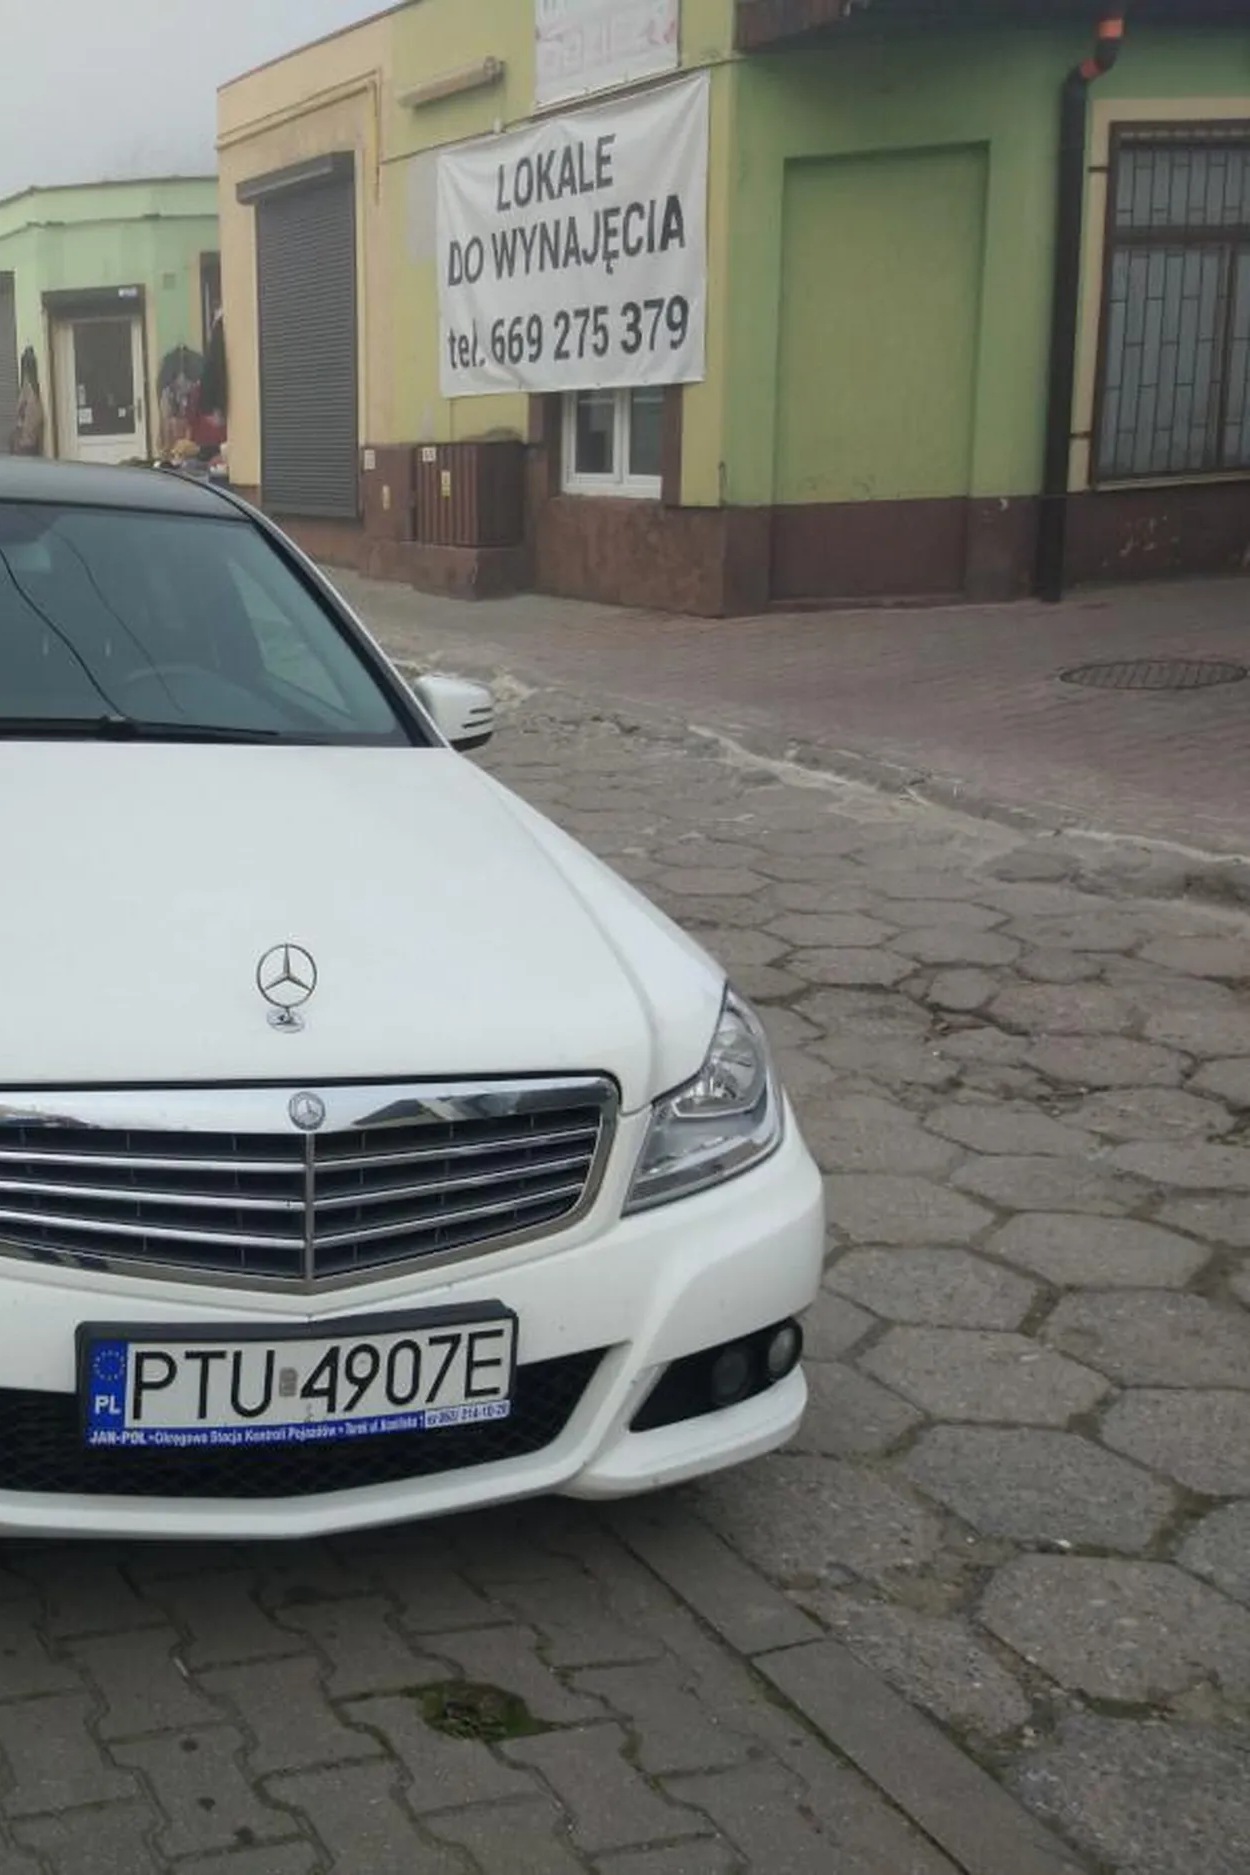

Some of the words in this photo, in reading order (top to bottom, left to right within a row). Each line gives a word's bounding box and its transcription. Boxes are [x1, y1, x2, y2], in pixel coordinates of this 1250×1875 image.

[497, 133, 616, 212] LOKALE
[448, 236, 484, 287] DO
[491, 194, 686, 281] WYNAJĘCIA
[449, 317, 486, 370] tel.
[491, 313, 543, 365] 669
[553, 304, 609, 361] 275
[620, 294, 689, 354] 379
[94, 1394, 121, 1415] PL
[133, 1349, 276, 1420] PTU
[300, 1328, 505, 1414] 4907E
[90, 1430, 147, 1445] JAN-POL
